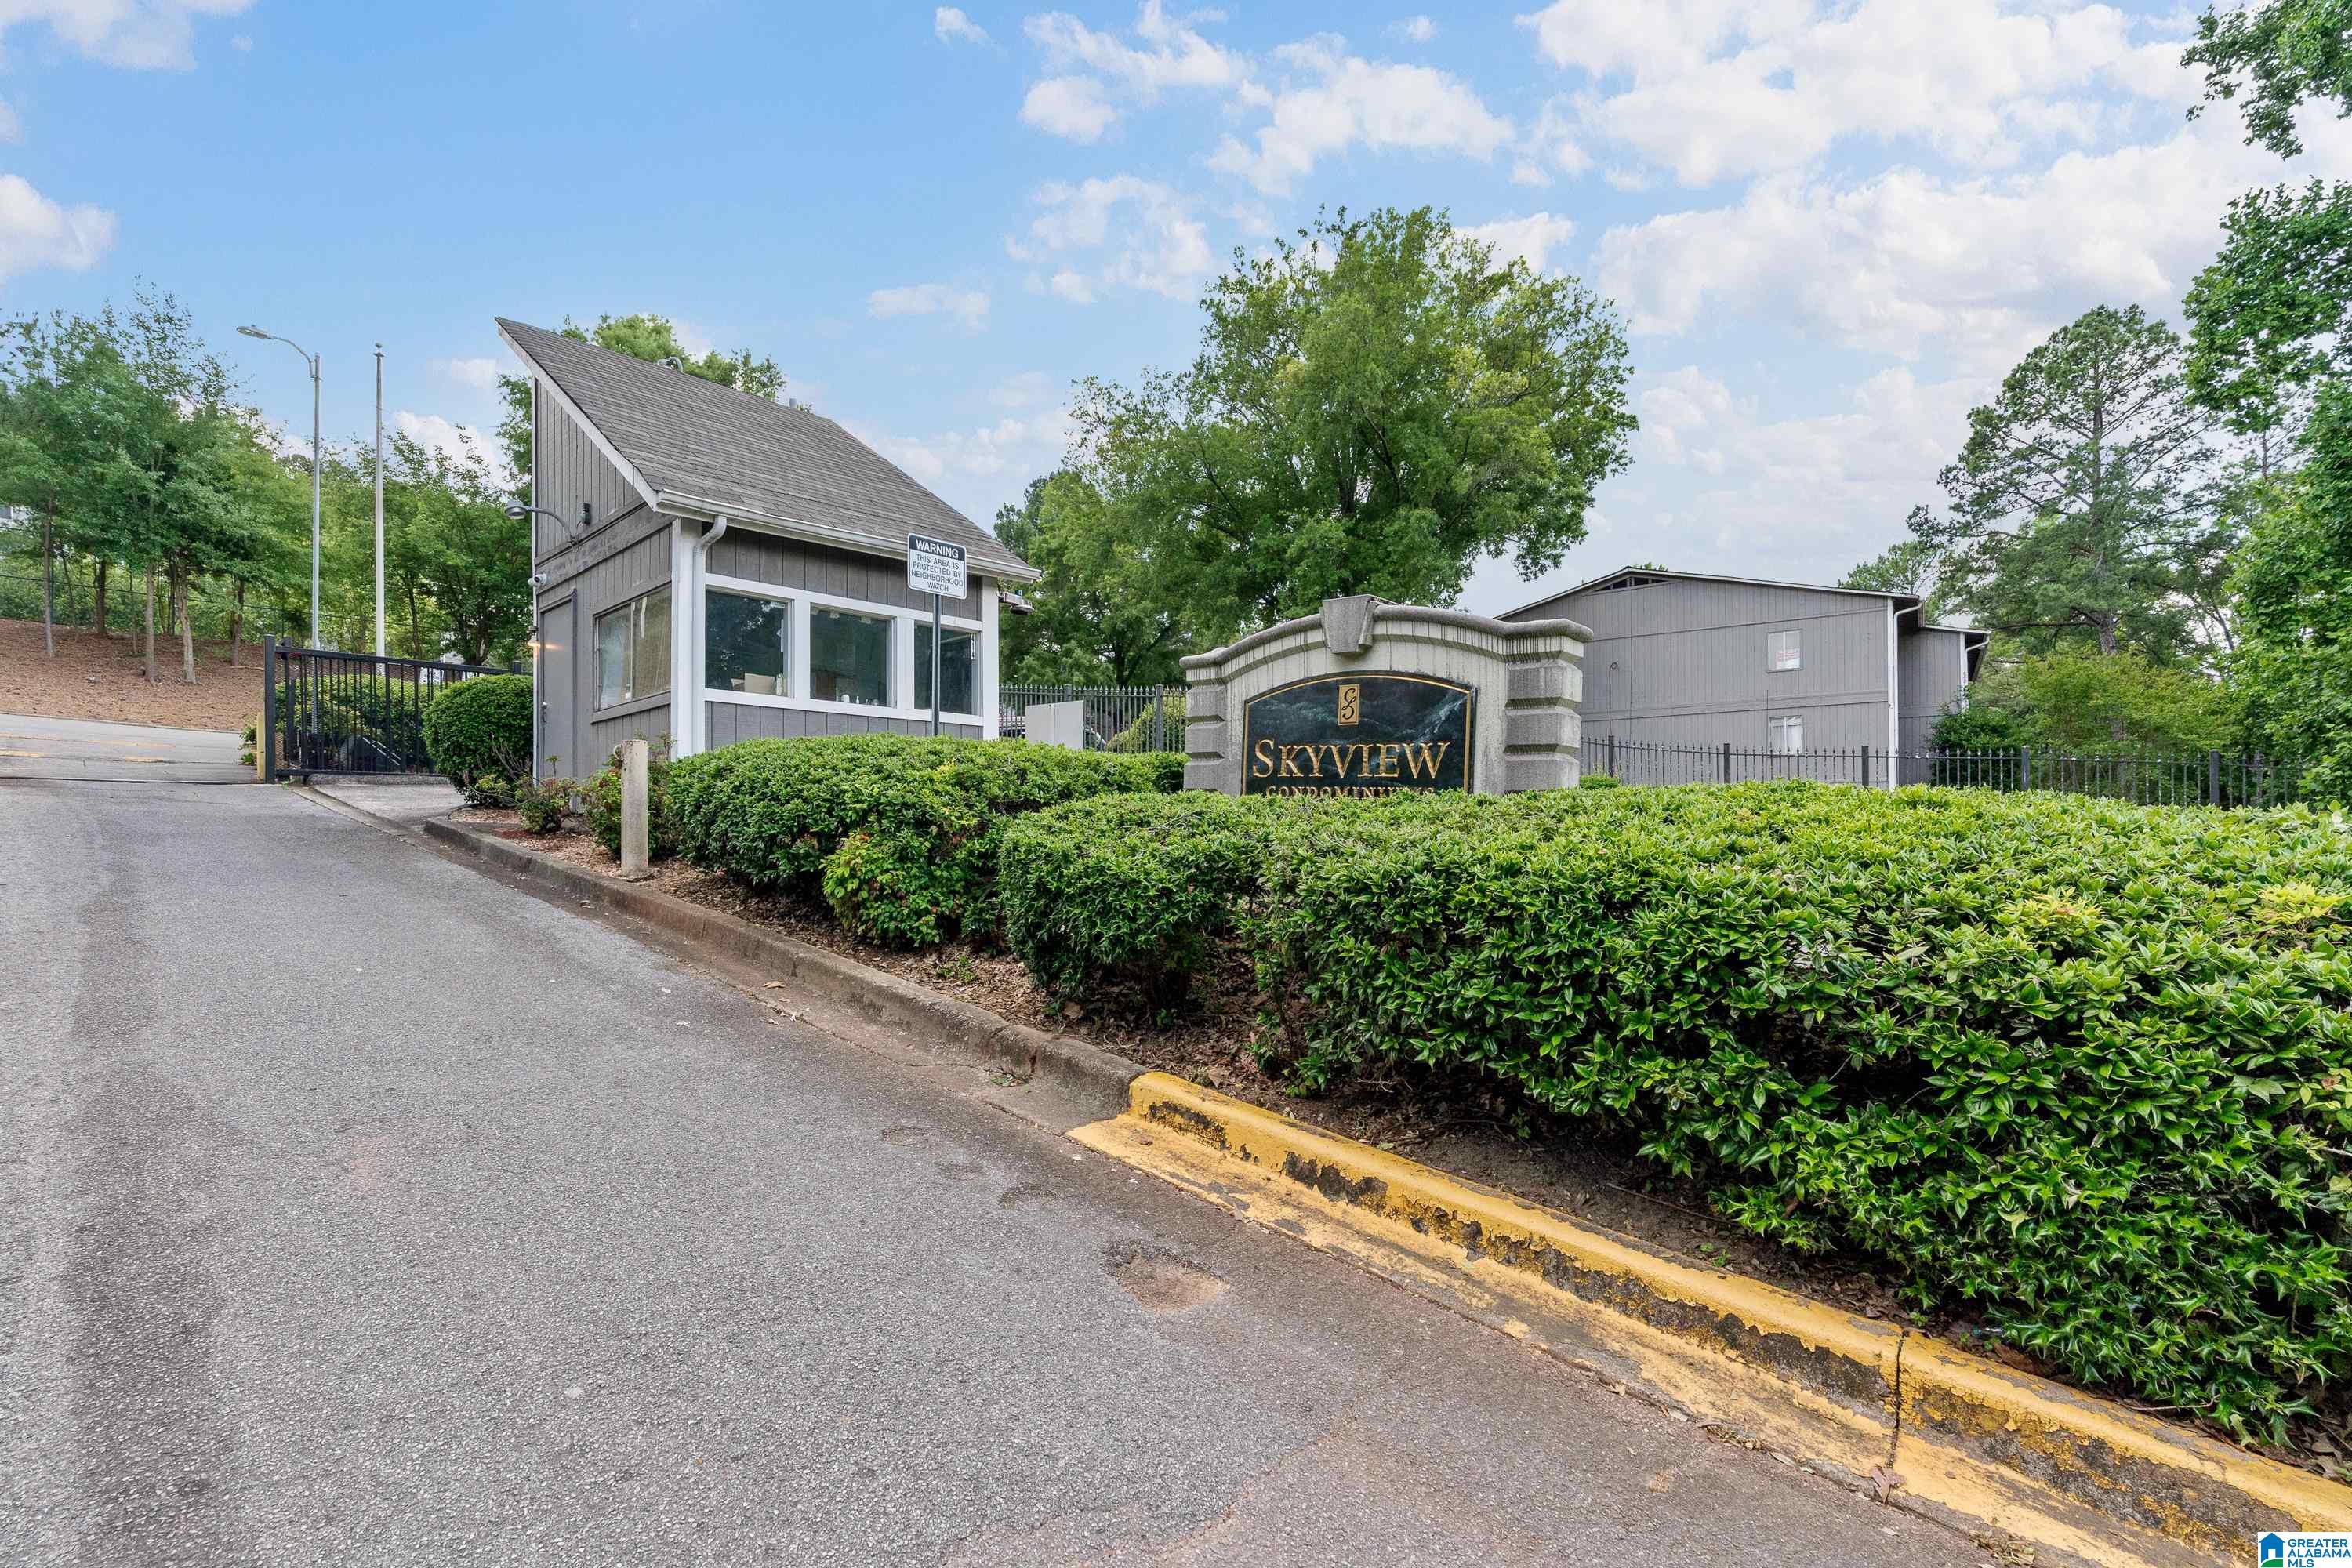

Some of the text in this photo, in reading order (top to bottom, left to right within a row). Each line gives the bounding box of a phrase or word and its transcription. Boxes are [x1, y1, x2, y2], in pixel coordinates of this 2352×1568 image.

[916, 539, 959, 558] WARNING
[913, 561, 951, 575] PROTECTED
[916, 554, 931, 564] THIS
[933, 557, 950, 568] AREA
[911, 570, 964, 586] NEIGHBORHOOD
[927, 581, 949, 592] WATCH
[1253, 739, 1450, 779] SKYVIEW
[1266, 786, 1435, 800] CONDOMINI
